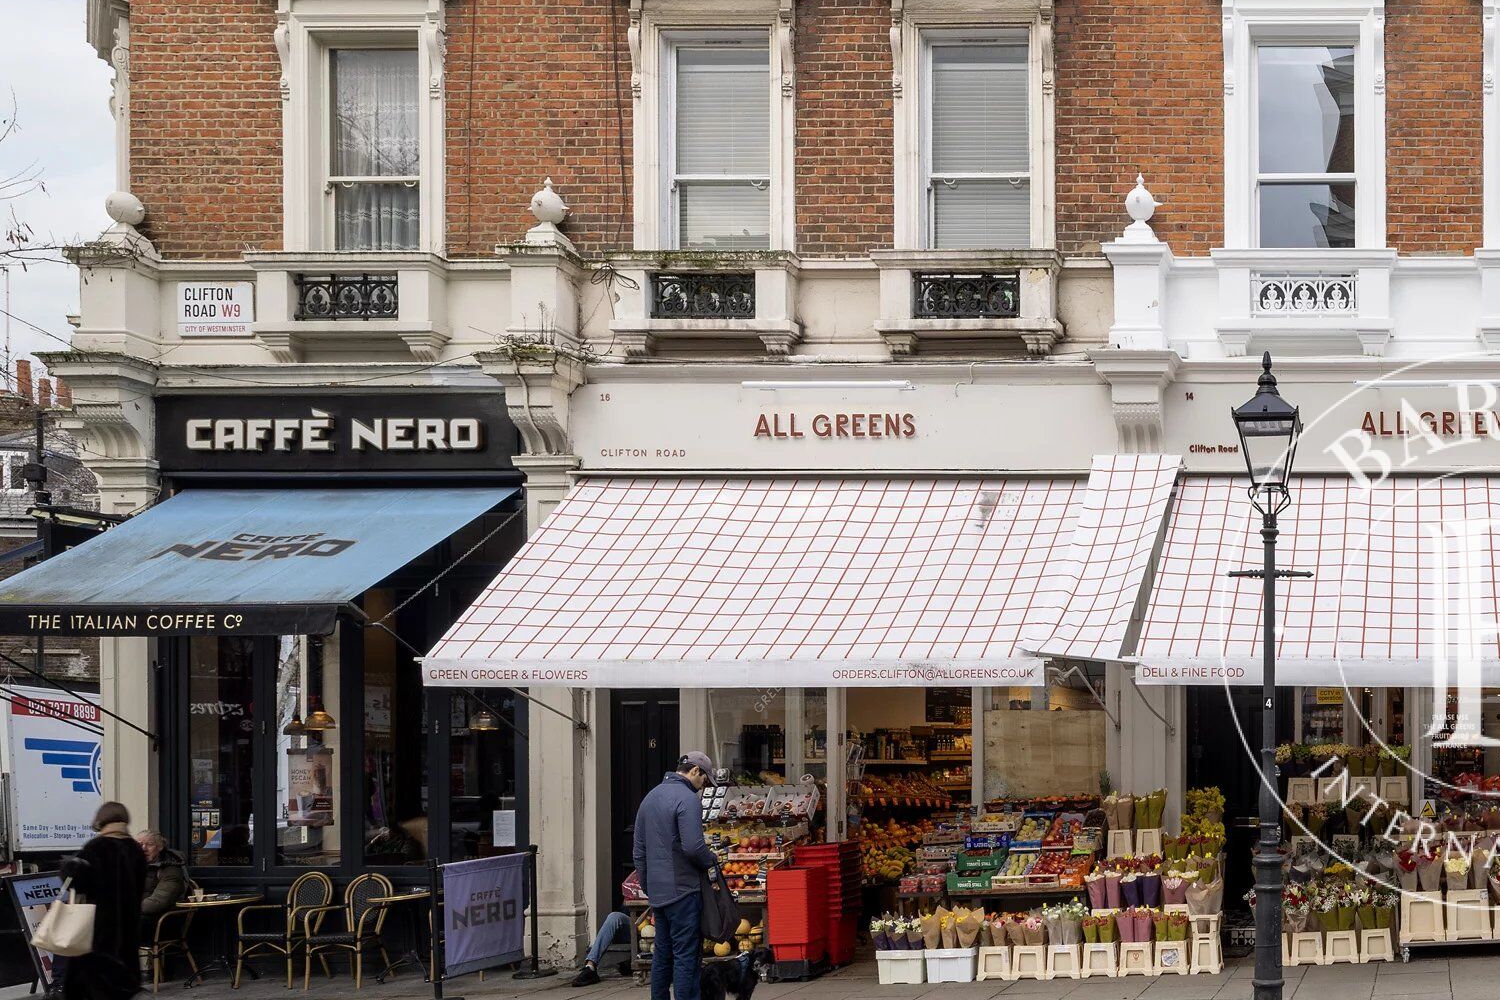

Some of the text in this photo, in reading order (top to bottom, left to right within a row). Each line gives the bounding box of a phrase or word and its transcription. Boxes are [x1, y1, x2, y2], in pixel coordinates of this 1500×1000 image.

[184, 287, 234, 301] CLIFTON
[184, 304, 241, 318] ROAD W9
[184, 325, 246, 333] CITY OF WESTMINSTER
[600, 393, 611, 402] 16
[1185, 392, 1194, 401] 14
[186, 407, 484, 451] CAFFÈ NERO
[754, 413, 916, 438] ALL GREENS
[1360, 411, 1411, 435] ALL
[600, 448, 686, 458] CLIFTON ROAD
[1189, 444, 1239, 453] Clifton Road
[149, 539, 358, 561] NERO
[28, 614, 61, 629] THE
[70, 615, 137, 630] ITALIAN
[146, 614, 216, 630] COFFEE
[429, 669, 588, 680] GREEN GROCER & FLOWERS
[832, 668, 1035, 681] ORDERS.CLIFTON@ALLGREENS.CO.UK
[1142, 667, 1245, 678] DELI & FINE FOOD
[1265, 698, 1272, 708] 4
[73, 704, 96, 720] 8899
[649, 739, 657, 749] 16
[23, 887, 62, 900] NERO
[452, 899, 517, 931] NERO
